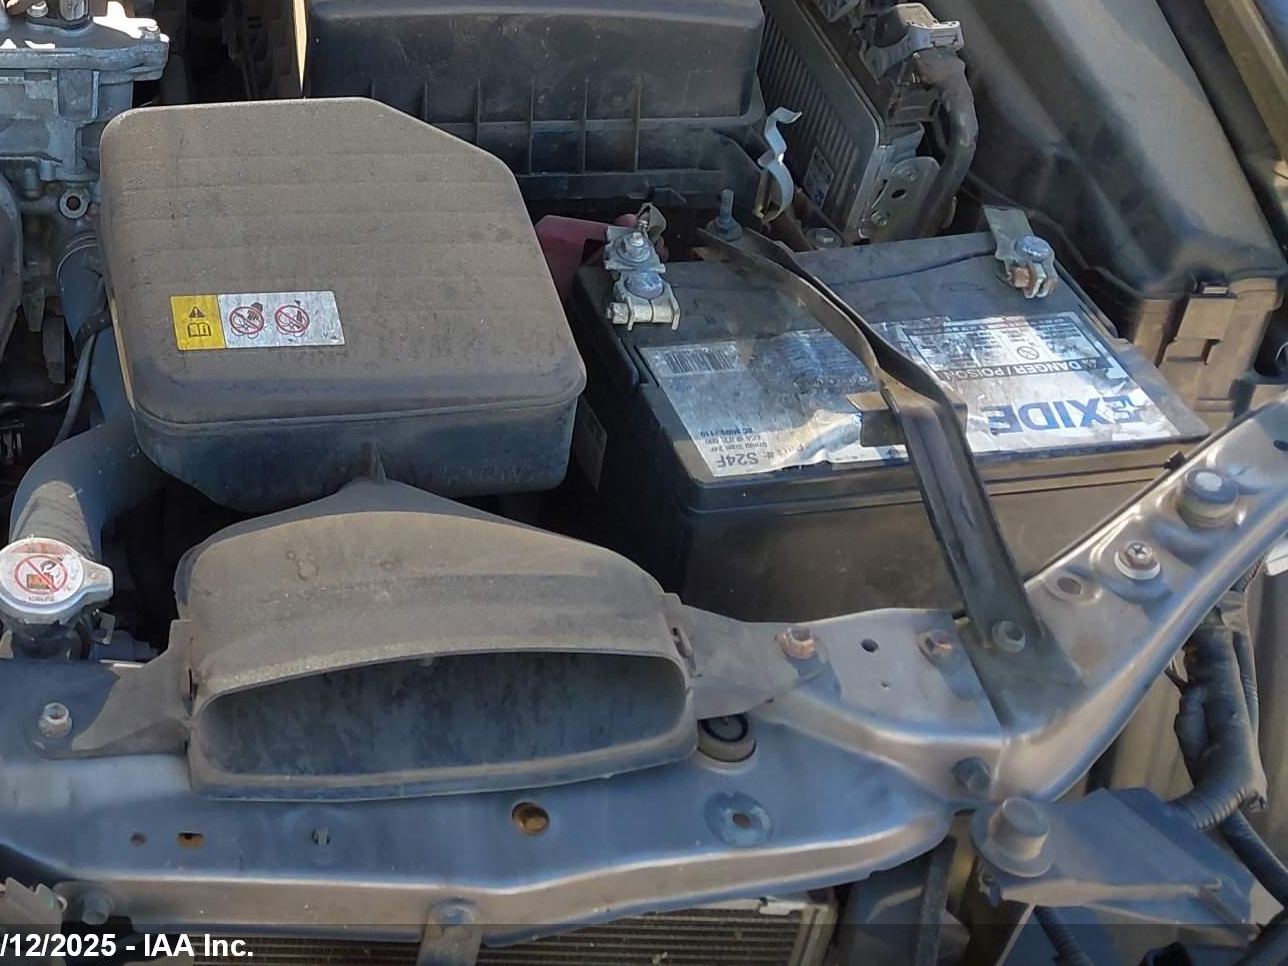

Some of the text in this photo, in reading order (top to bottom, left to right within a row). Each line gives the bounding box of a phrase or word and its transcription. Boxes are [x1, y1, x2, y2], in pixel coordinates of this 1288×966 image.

[943, 365, 1003, 380] POISON
[1012, 360, 1080, 376] DANGER
[982, 396, 1144, 435] EXIDE
[717, 451, 759, 468] S24F
